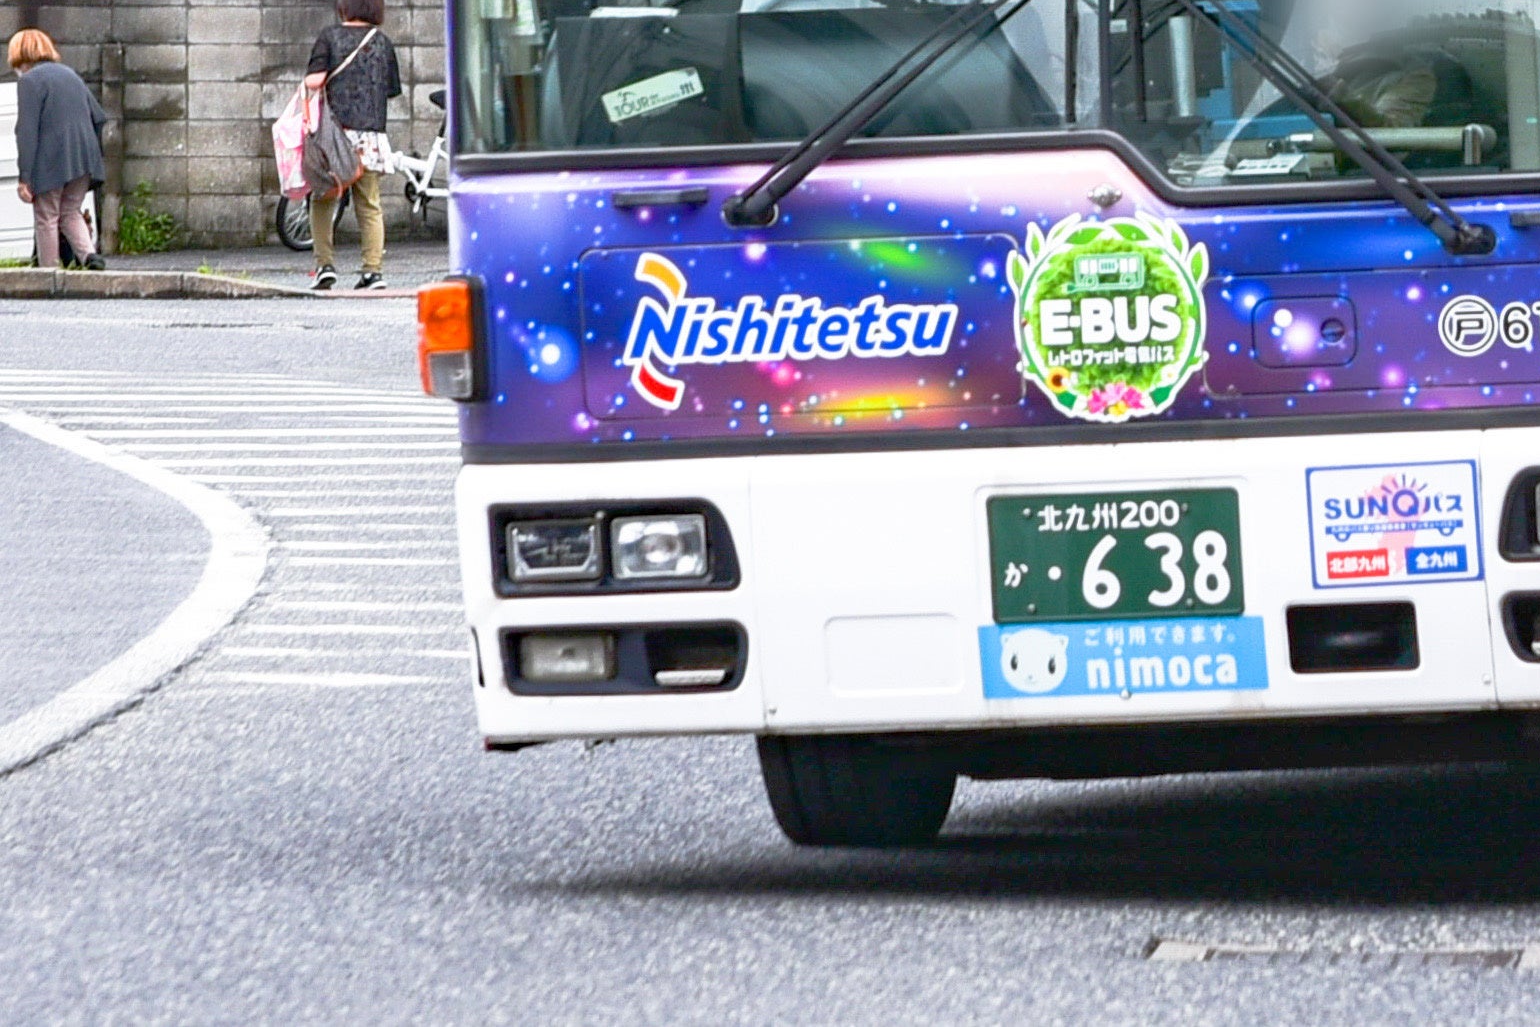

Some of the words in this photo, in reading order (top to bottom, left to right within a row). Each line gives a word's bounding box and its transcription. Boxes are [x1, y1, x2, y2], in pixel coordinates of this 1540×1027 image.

[625, 295, 958, 365] Nishitetsu
[1039, 293, 1182, 346] E-BUS
[1328, 555, 1387, 574] 北部九州
[1415, 550, 1459, 570] 全九州
[1004, 561, 1029, 588] か
[1084, 623, 1236, 647] ご利用できます。
[1086, 646, 1239, 690] nimoca
